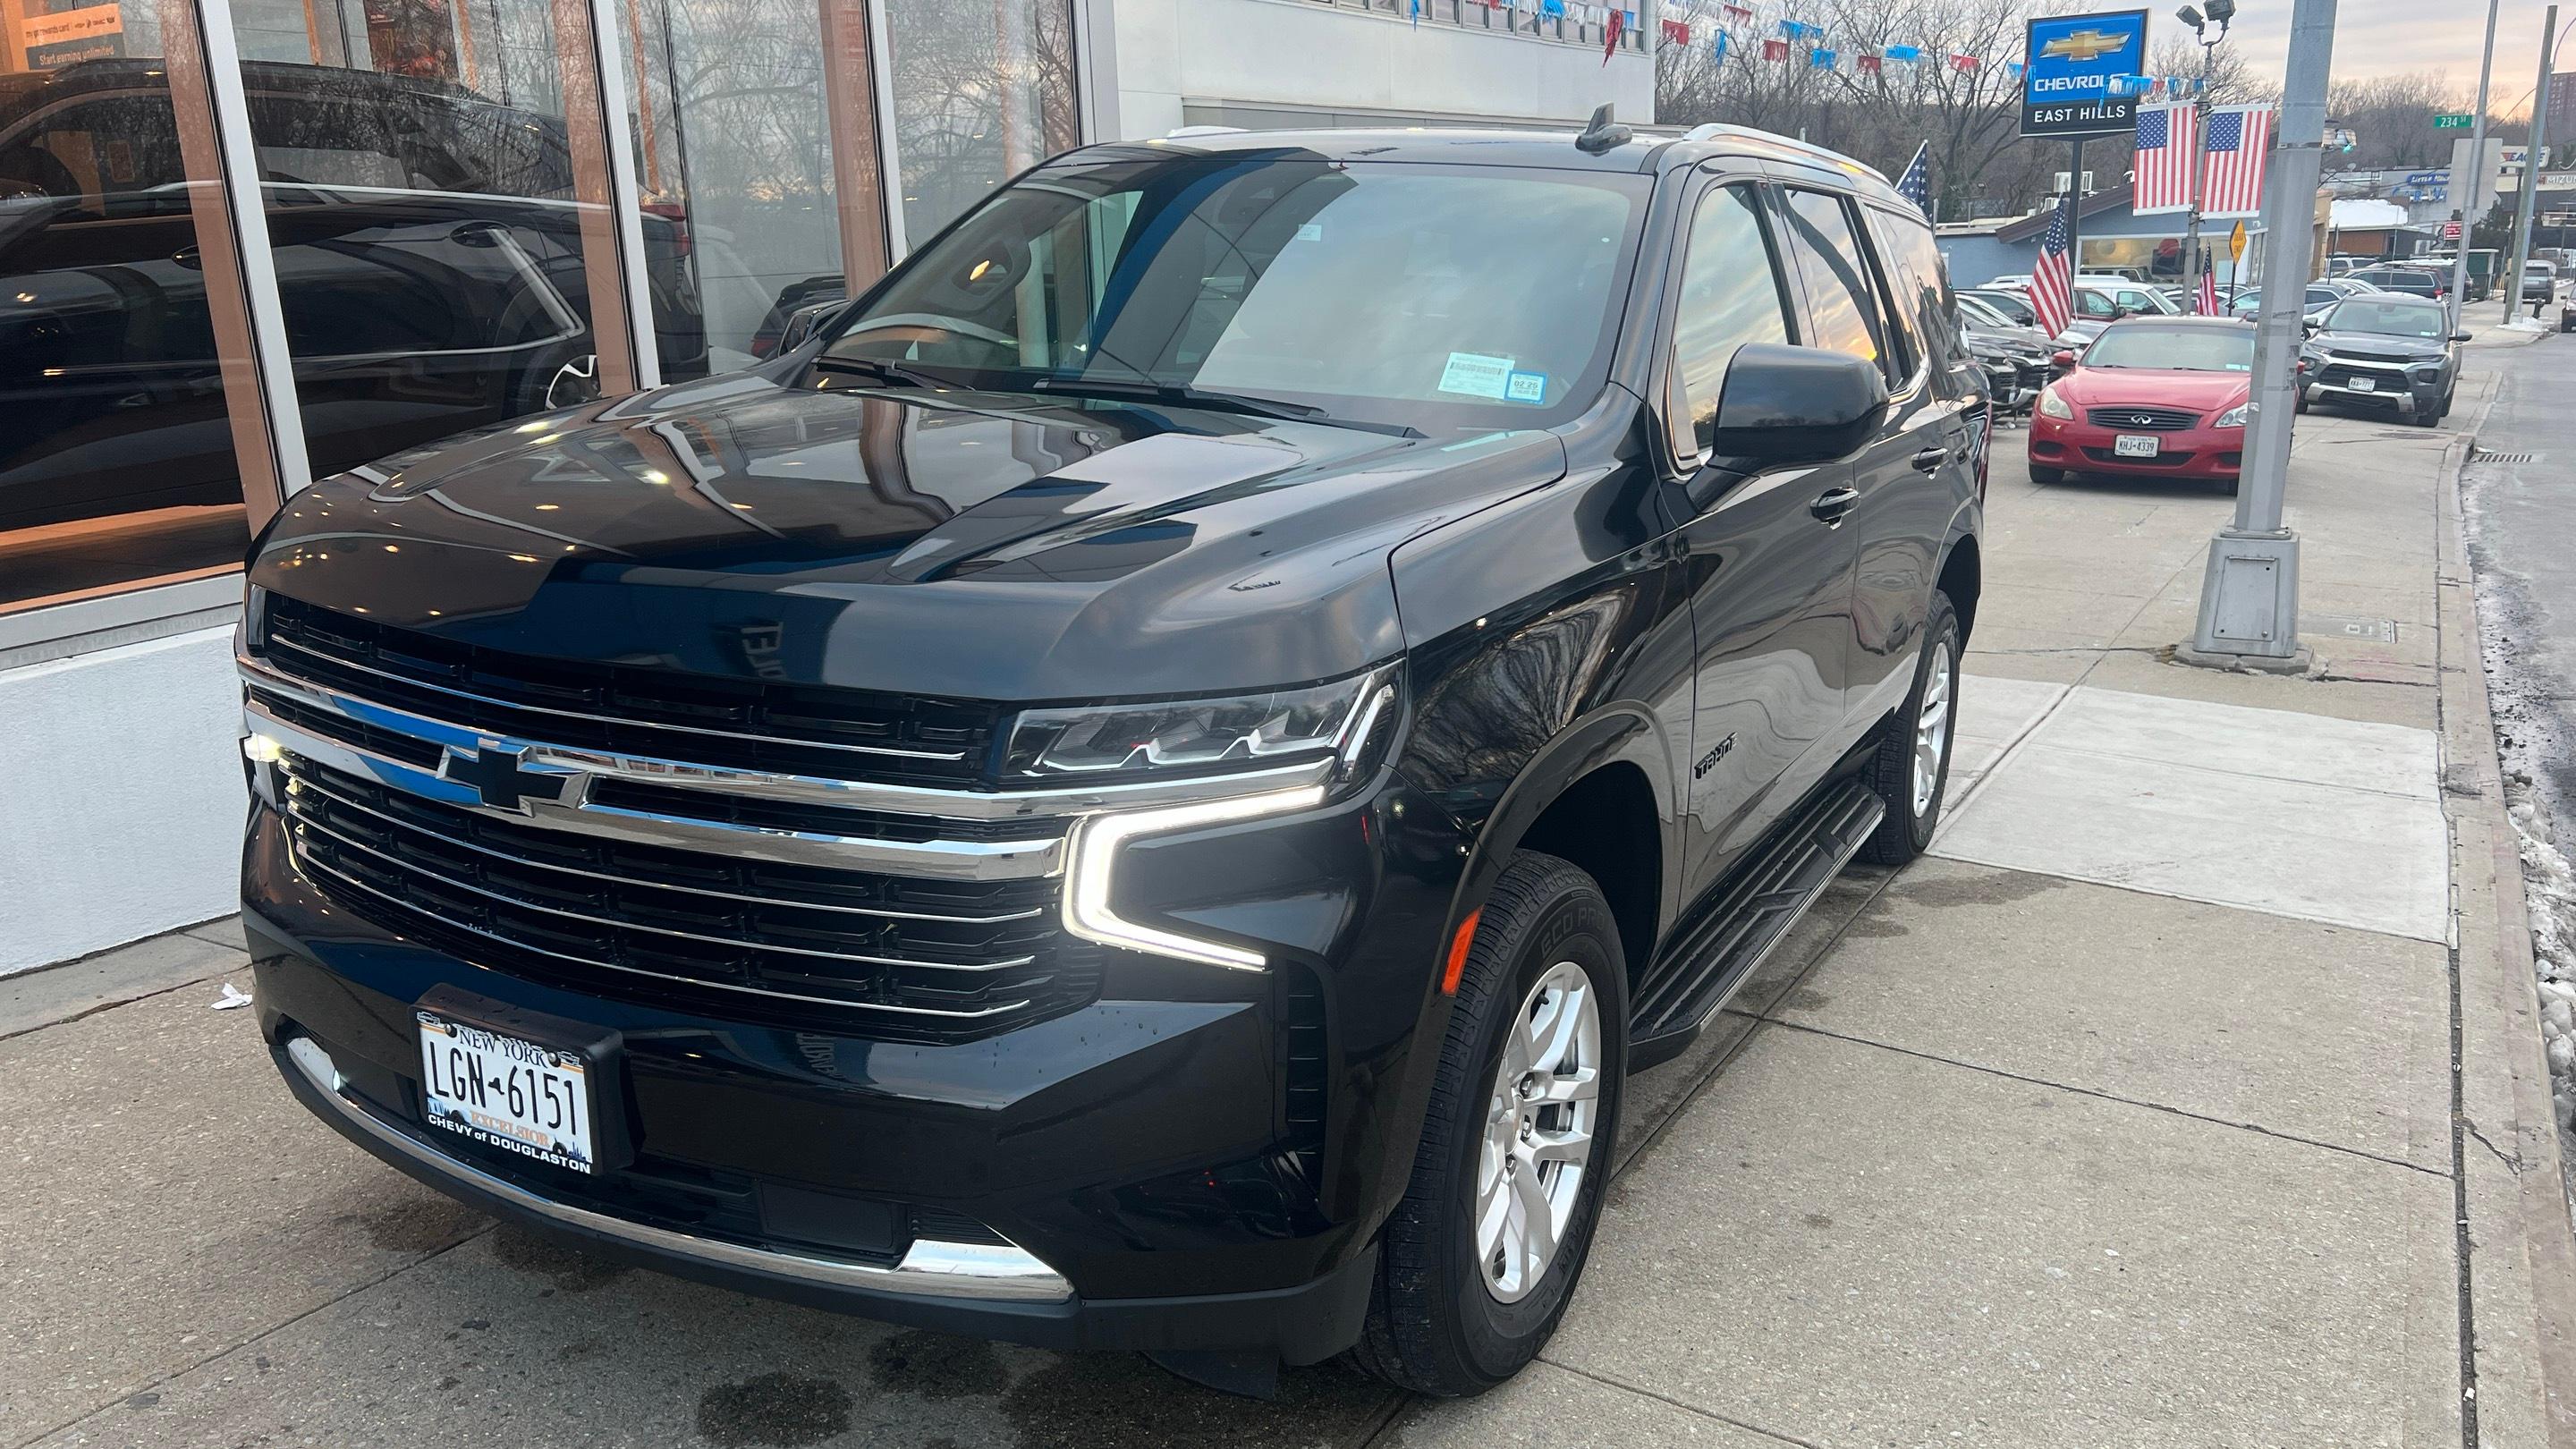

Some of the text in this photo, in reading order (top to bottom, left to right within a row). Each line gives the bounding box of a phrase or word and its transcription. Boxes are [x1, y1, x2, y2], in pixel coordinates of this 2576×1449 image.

[39, 44, 114, 65] Start earning unlimited
[2034, 73, 2130, 92] CHEVROL
[2034, 105, 2126, 123] EAST HILLS
[2440, 116, 2458, 128] 234
[1693, 732, 1738, 779] TAHOE
[1577, 906, 1606, 931] PRO
[460, 1030, 496, 1054] NEW
[502, 1041, 548, 1069] YORK
[471, 1110, 551, 1148] EXCELSIOR
[428, 1114, 590, 1174] CHEVY of DOUGLASTON
